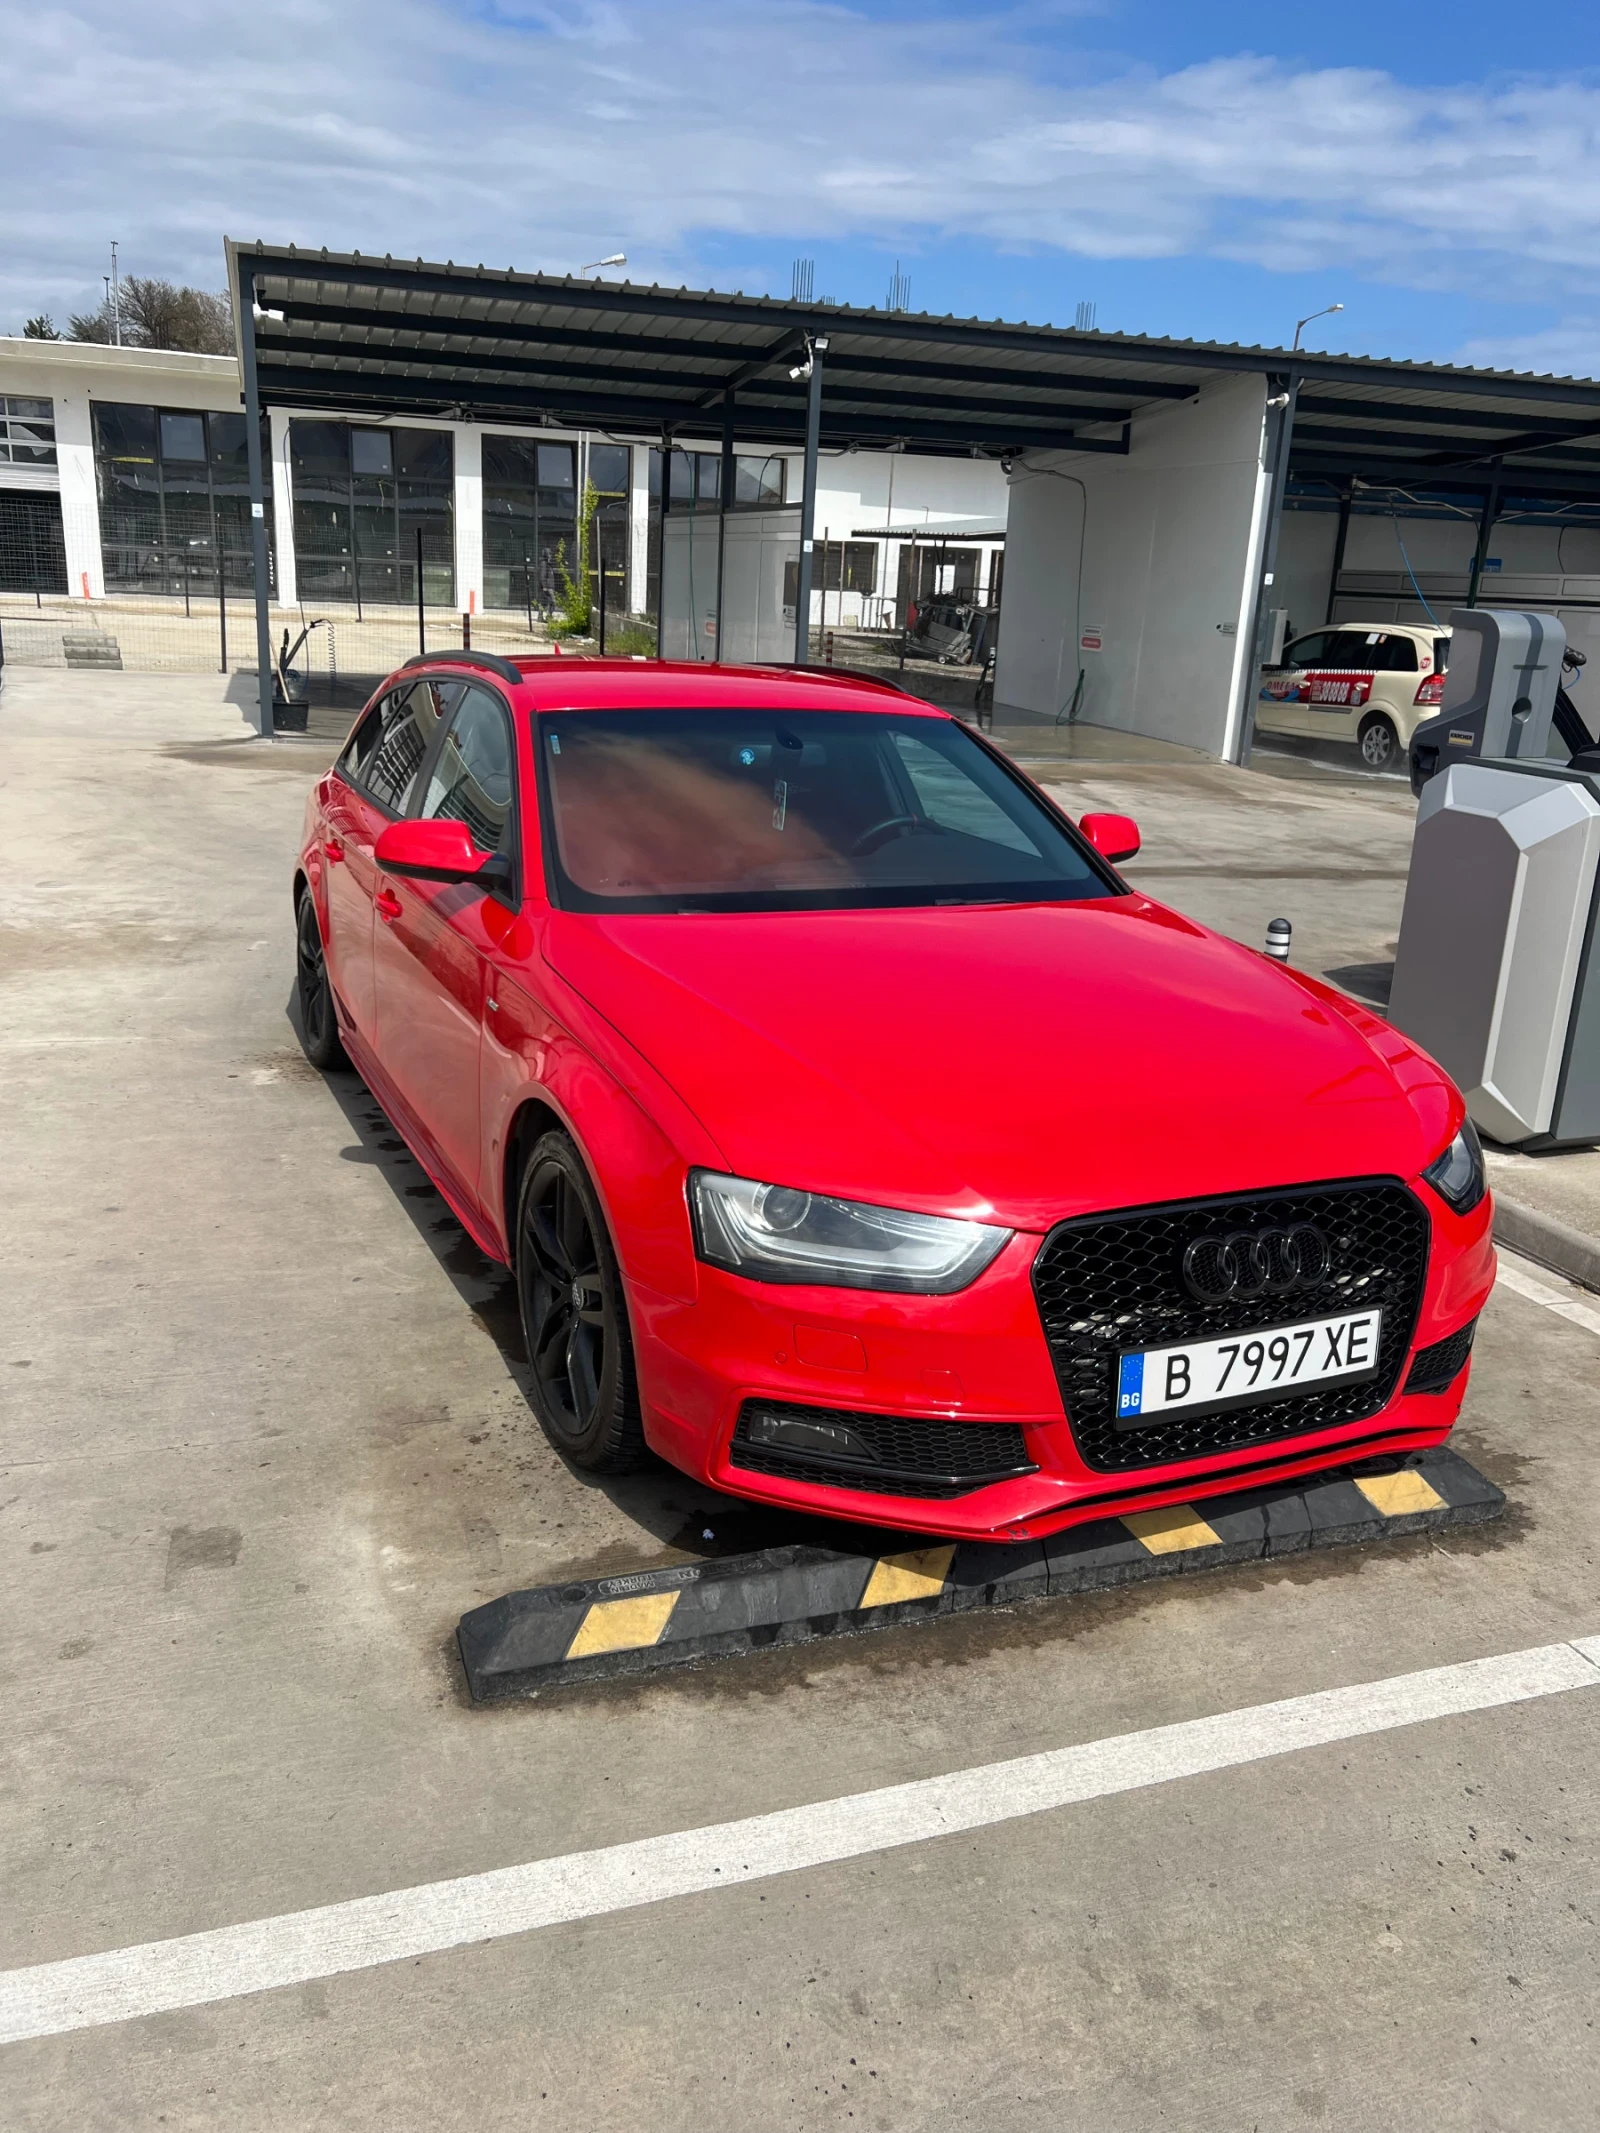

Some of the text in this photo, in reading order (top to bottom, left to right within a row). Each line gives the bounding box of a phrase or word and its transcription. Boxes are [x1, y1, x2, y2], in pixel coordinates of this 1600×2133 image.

[1165, 1319, 1372, 1401] B 7997 XE
[1121, 1392, 1140, 1408] BG
[609, 1574, 652, 1587] TURKEY
